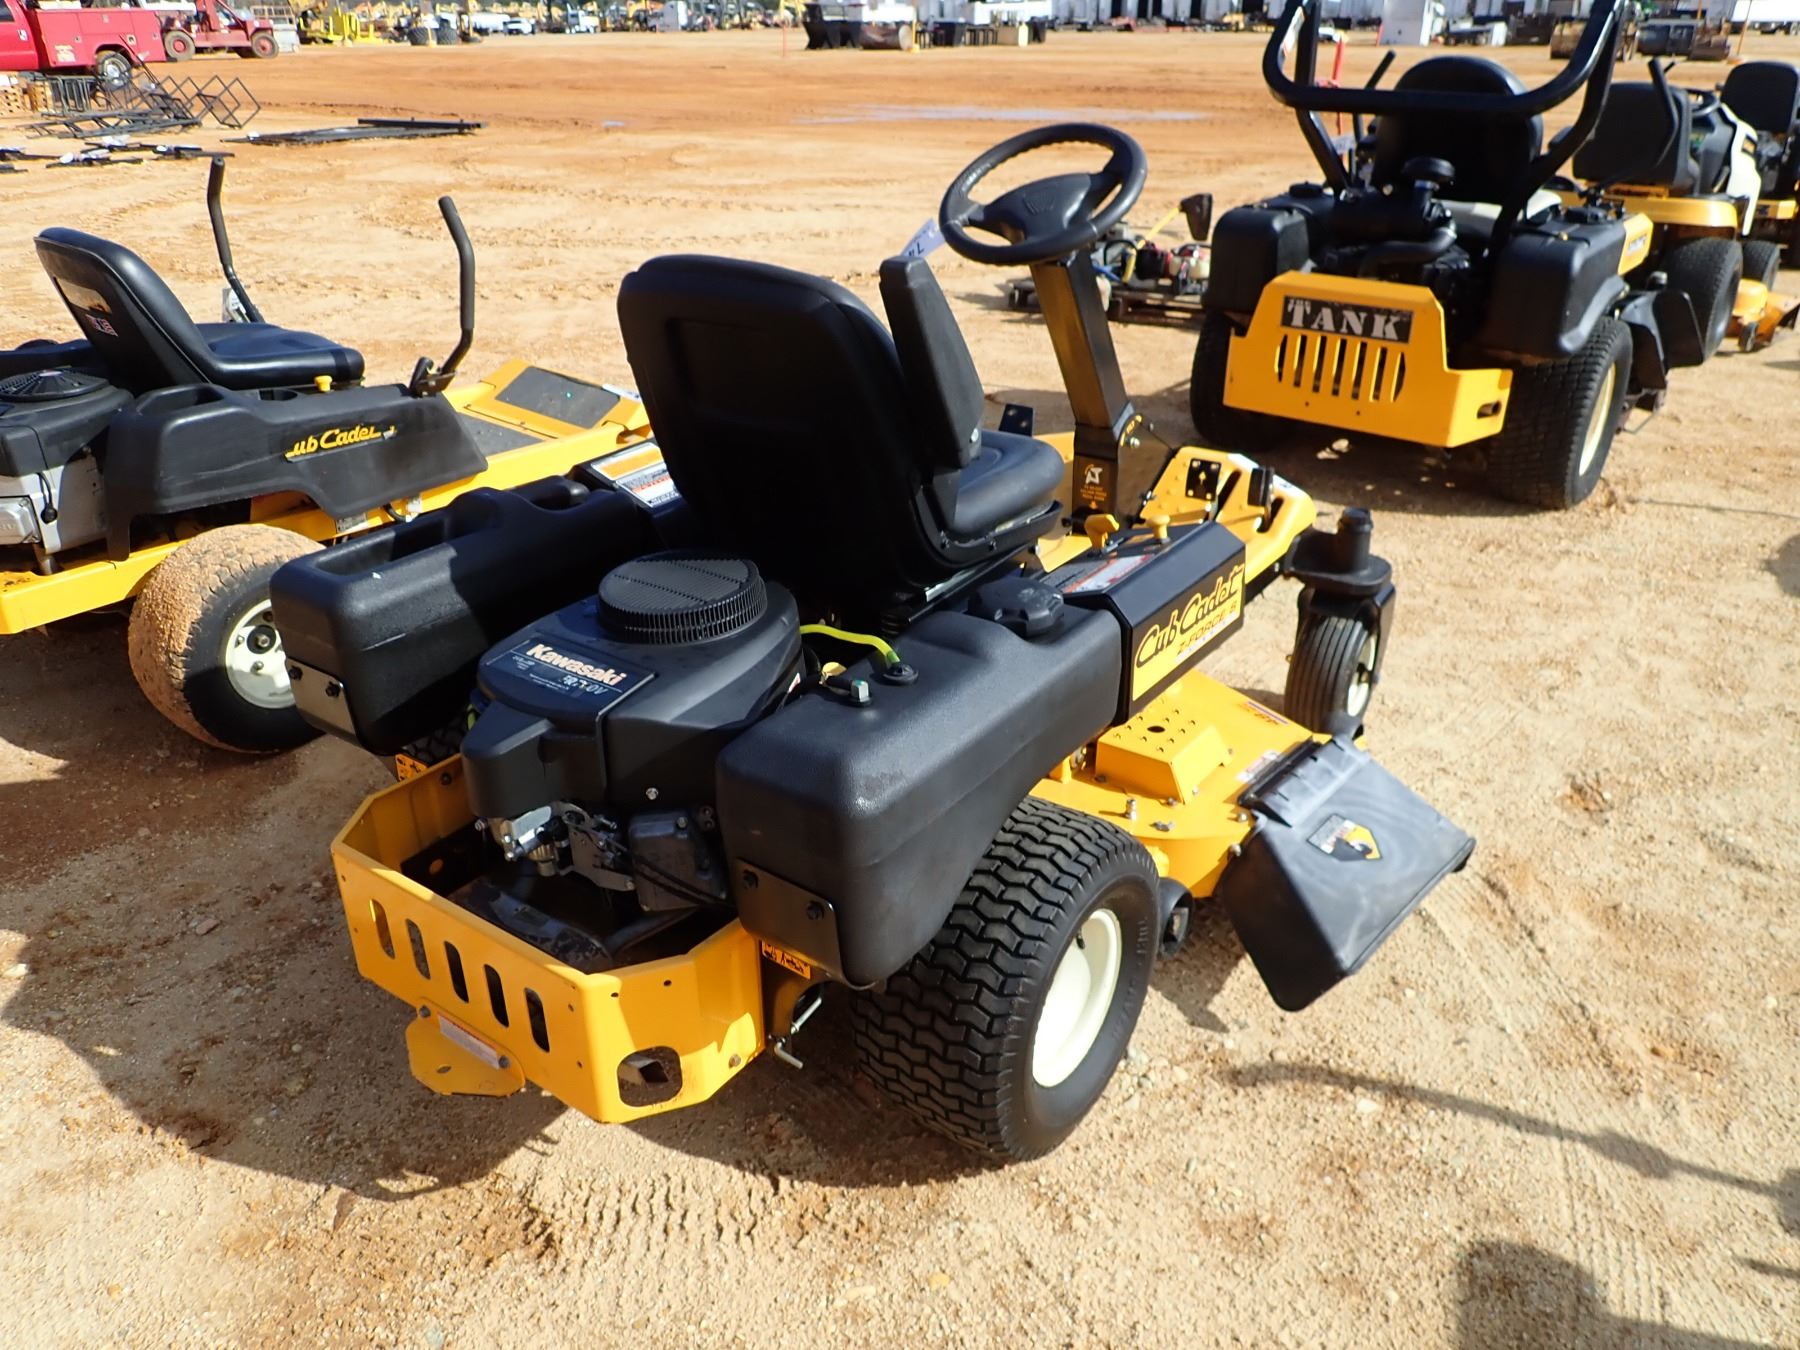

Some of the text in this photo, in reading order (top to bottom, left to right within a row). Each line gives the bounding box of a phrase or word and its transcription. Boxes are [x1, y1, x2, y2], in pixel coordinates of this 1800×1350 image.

[1286, 298, 1401, 341] TANK
[1135, 608, 1179, 668] Cub
[1179, 563, 1245, 636] Cadet
[526, 643, 627, 686] Kawasaki
